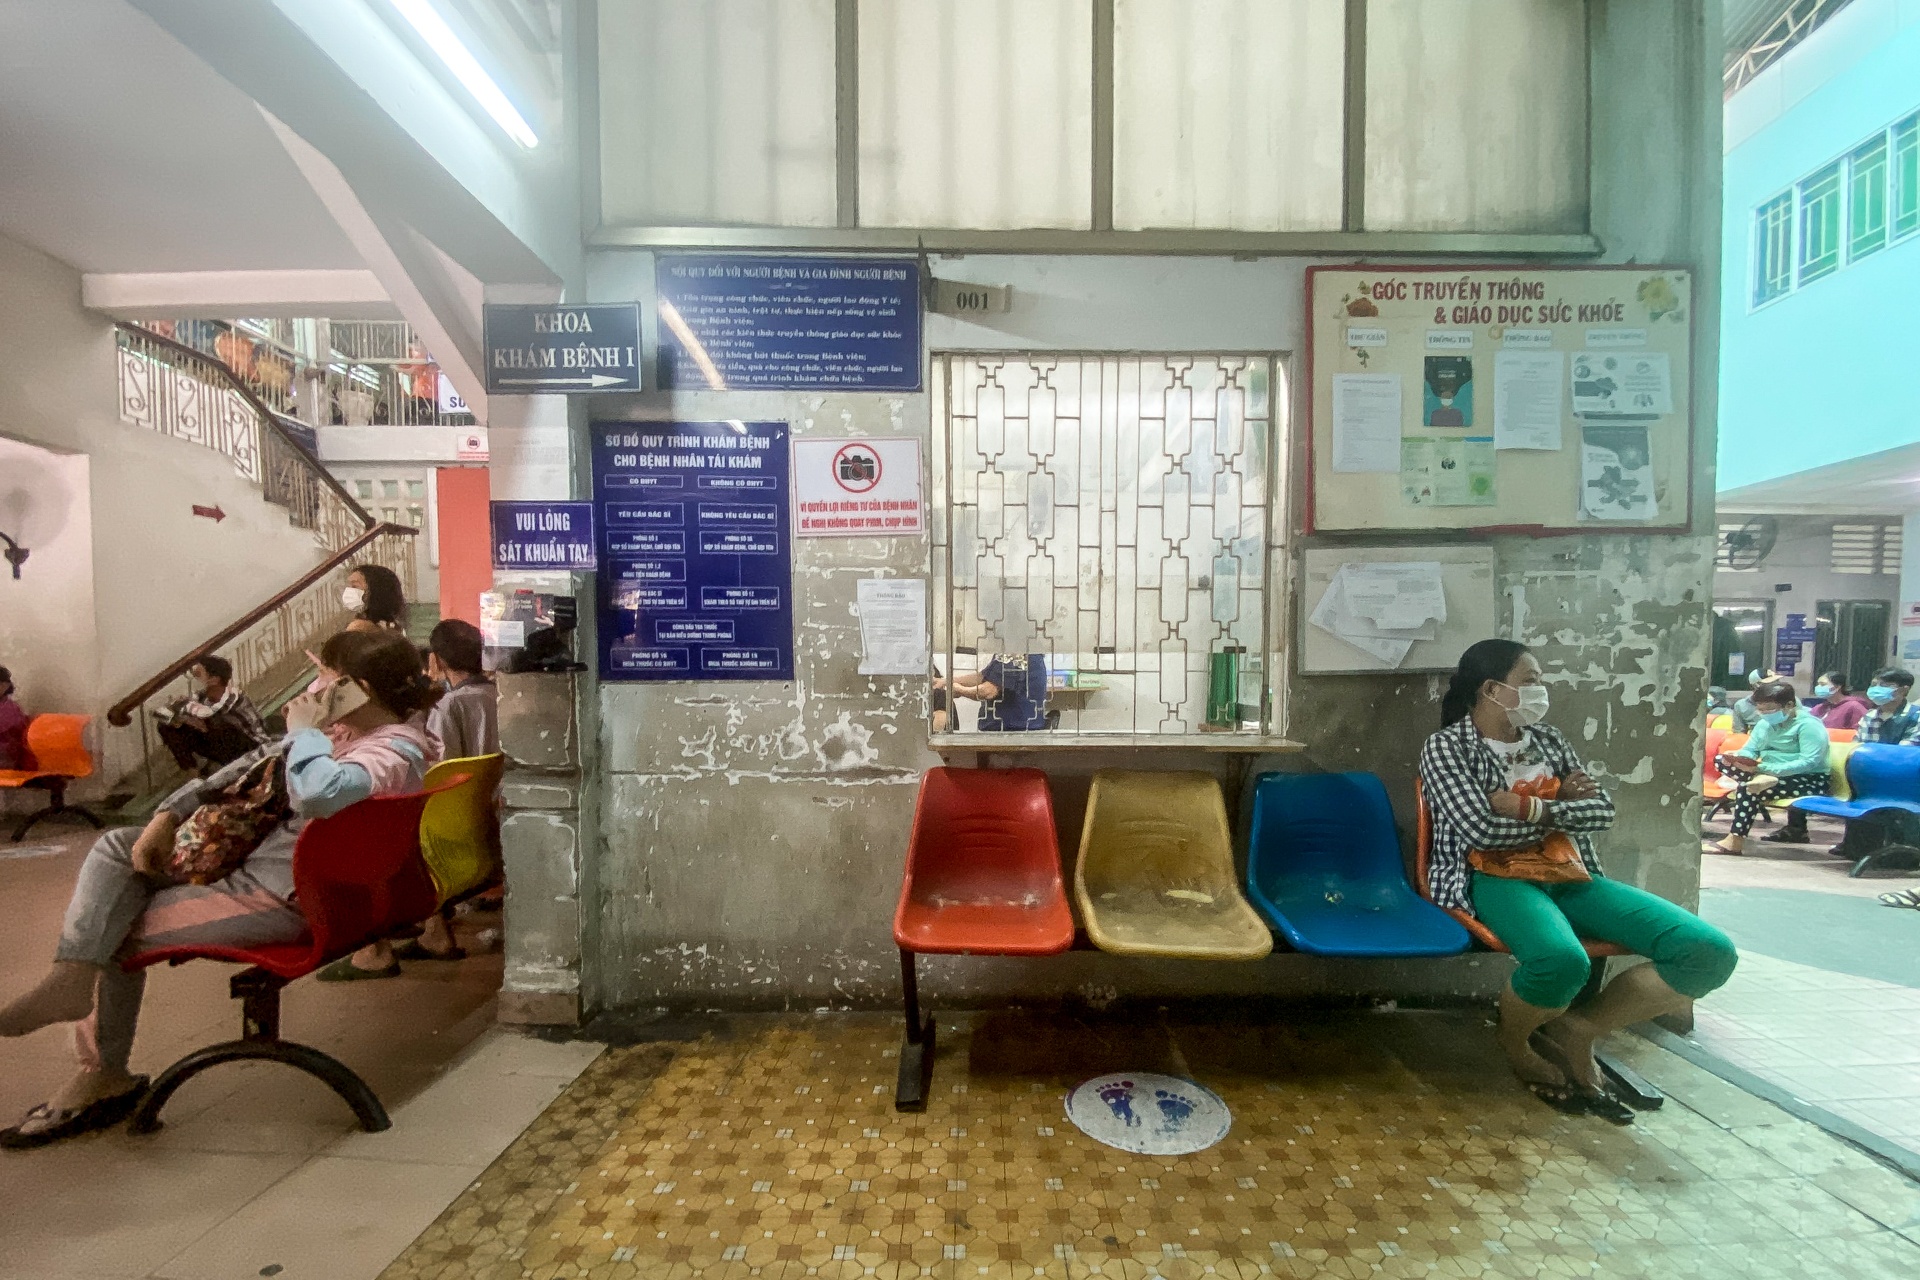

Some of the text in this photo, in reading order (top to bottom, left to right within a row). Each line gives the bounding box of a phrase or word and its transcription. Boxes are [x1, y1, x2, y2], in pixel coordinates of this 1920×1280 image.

[688, 266, 705, 279] QUY
[708, 263, 724, 279] ĐỐI
[726, 265, 741, 279] VỚI
[743, 265, 771, 279] NGƯỜI
[773, 265, 797, 280] BỆNH
[799, 267, 810, 279] VÀ
[812, 267, 828, 279] GIA
[830, 266, 852, 280] ĐÌNH
[854, 267, 881, 280] NGƯỜI
[883, 268, 907, 281] BỆNH
[1372, 275, 1545, 300] GÓC TRUYỀN THÔNG
[956, 288, 988, 310] 001
[534, 311, 593, 333] KHOA
[1434, 306, 1447, 324] &
[1451, 301, 1492, 324] GIÁO
[1499, 305, 1533, 327] DỤC
[1538, 299, 1573, 324] SỨC
[494, 341, 635, 373] KHÁM BỆNH I
[605, 432, 770, 451] SƠ ĐỒ QUY TRÌNH KHÁM BỆNH
[614, 453, 762, 469] CHO BỆNH NHÂN TÁI KHÁM
[711, 479, 764, 487] KHÔNG CÓ BHYT
[701, 511, 766, 519] KHÔNG YÊU CẦU BÁC
[800, 499, 917, 513] VÌ QUYỀN LỢI RIÊNG TƯ CỦA BỆNH NHÂN
[515, 510, 570, 531] VUI LÒNG
[802, 515, 918, 530] ĐỀ NGHỊ KHÔNG QUAY PHIM, CHỤP HÌNH
[499, 536, 589, 562] SÁT KHUẨN TAY
